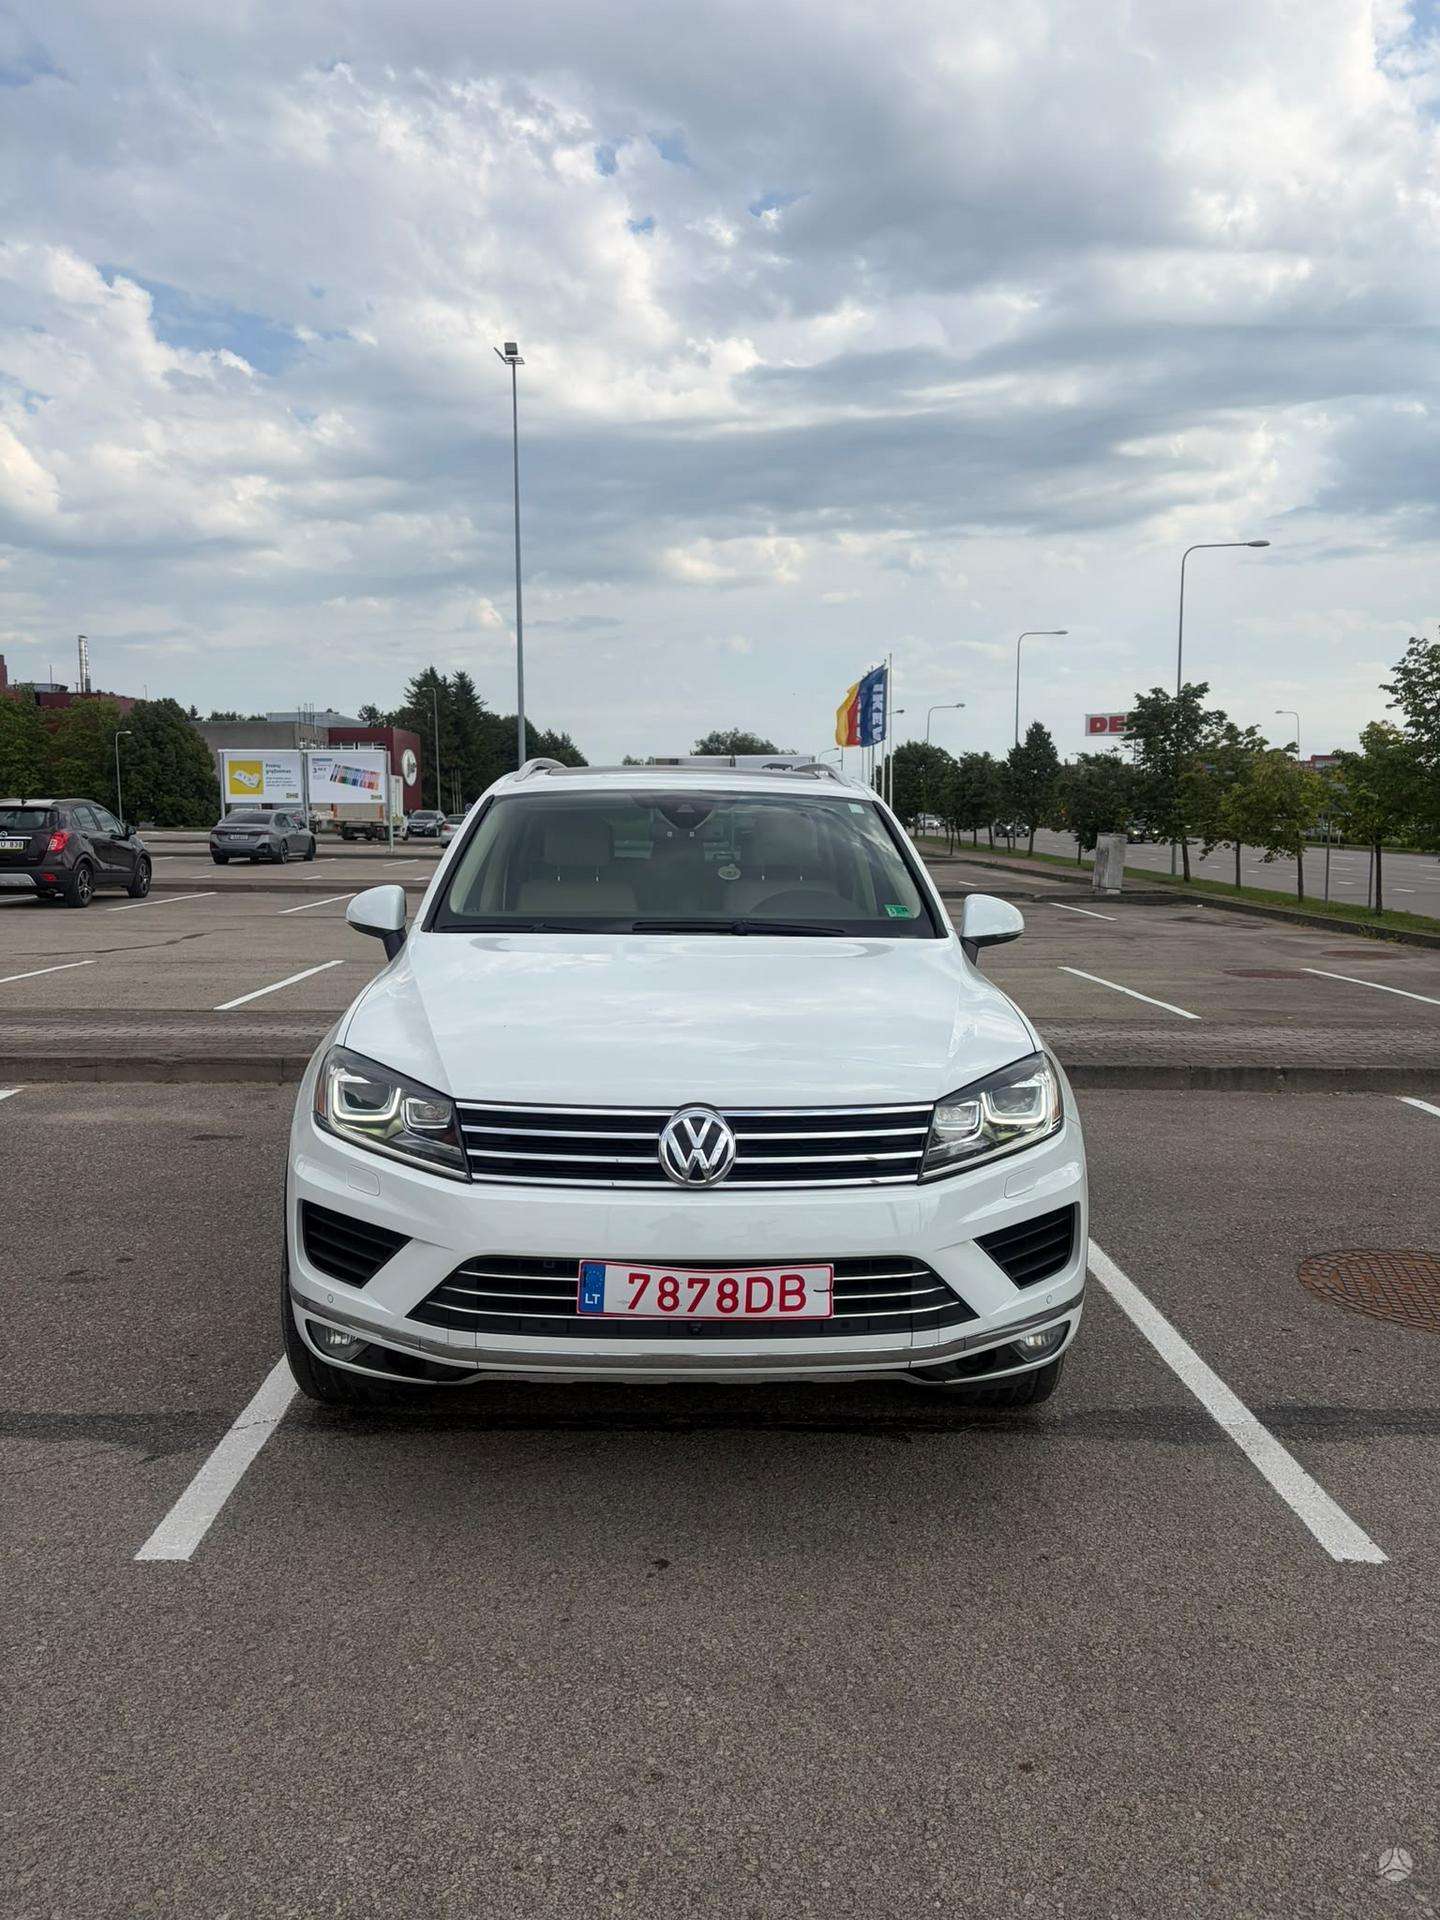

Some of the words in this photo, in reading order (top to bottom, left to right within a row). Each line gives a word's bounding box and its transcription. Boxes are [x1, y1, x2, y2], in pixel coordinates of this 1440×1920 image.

[1089, 714, 1135, 733] DE
[585, 1292, 601, 1305] LT
[628, 1272, 807, 1314] 7878DB
